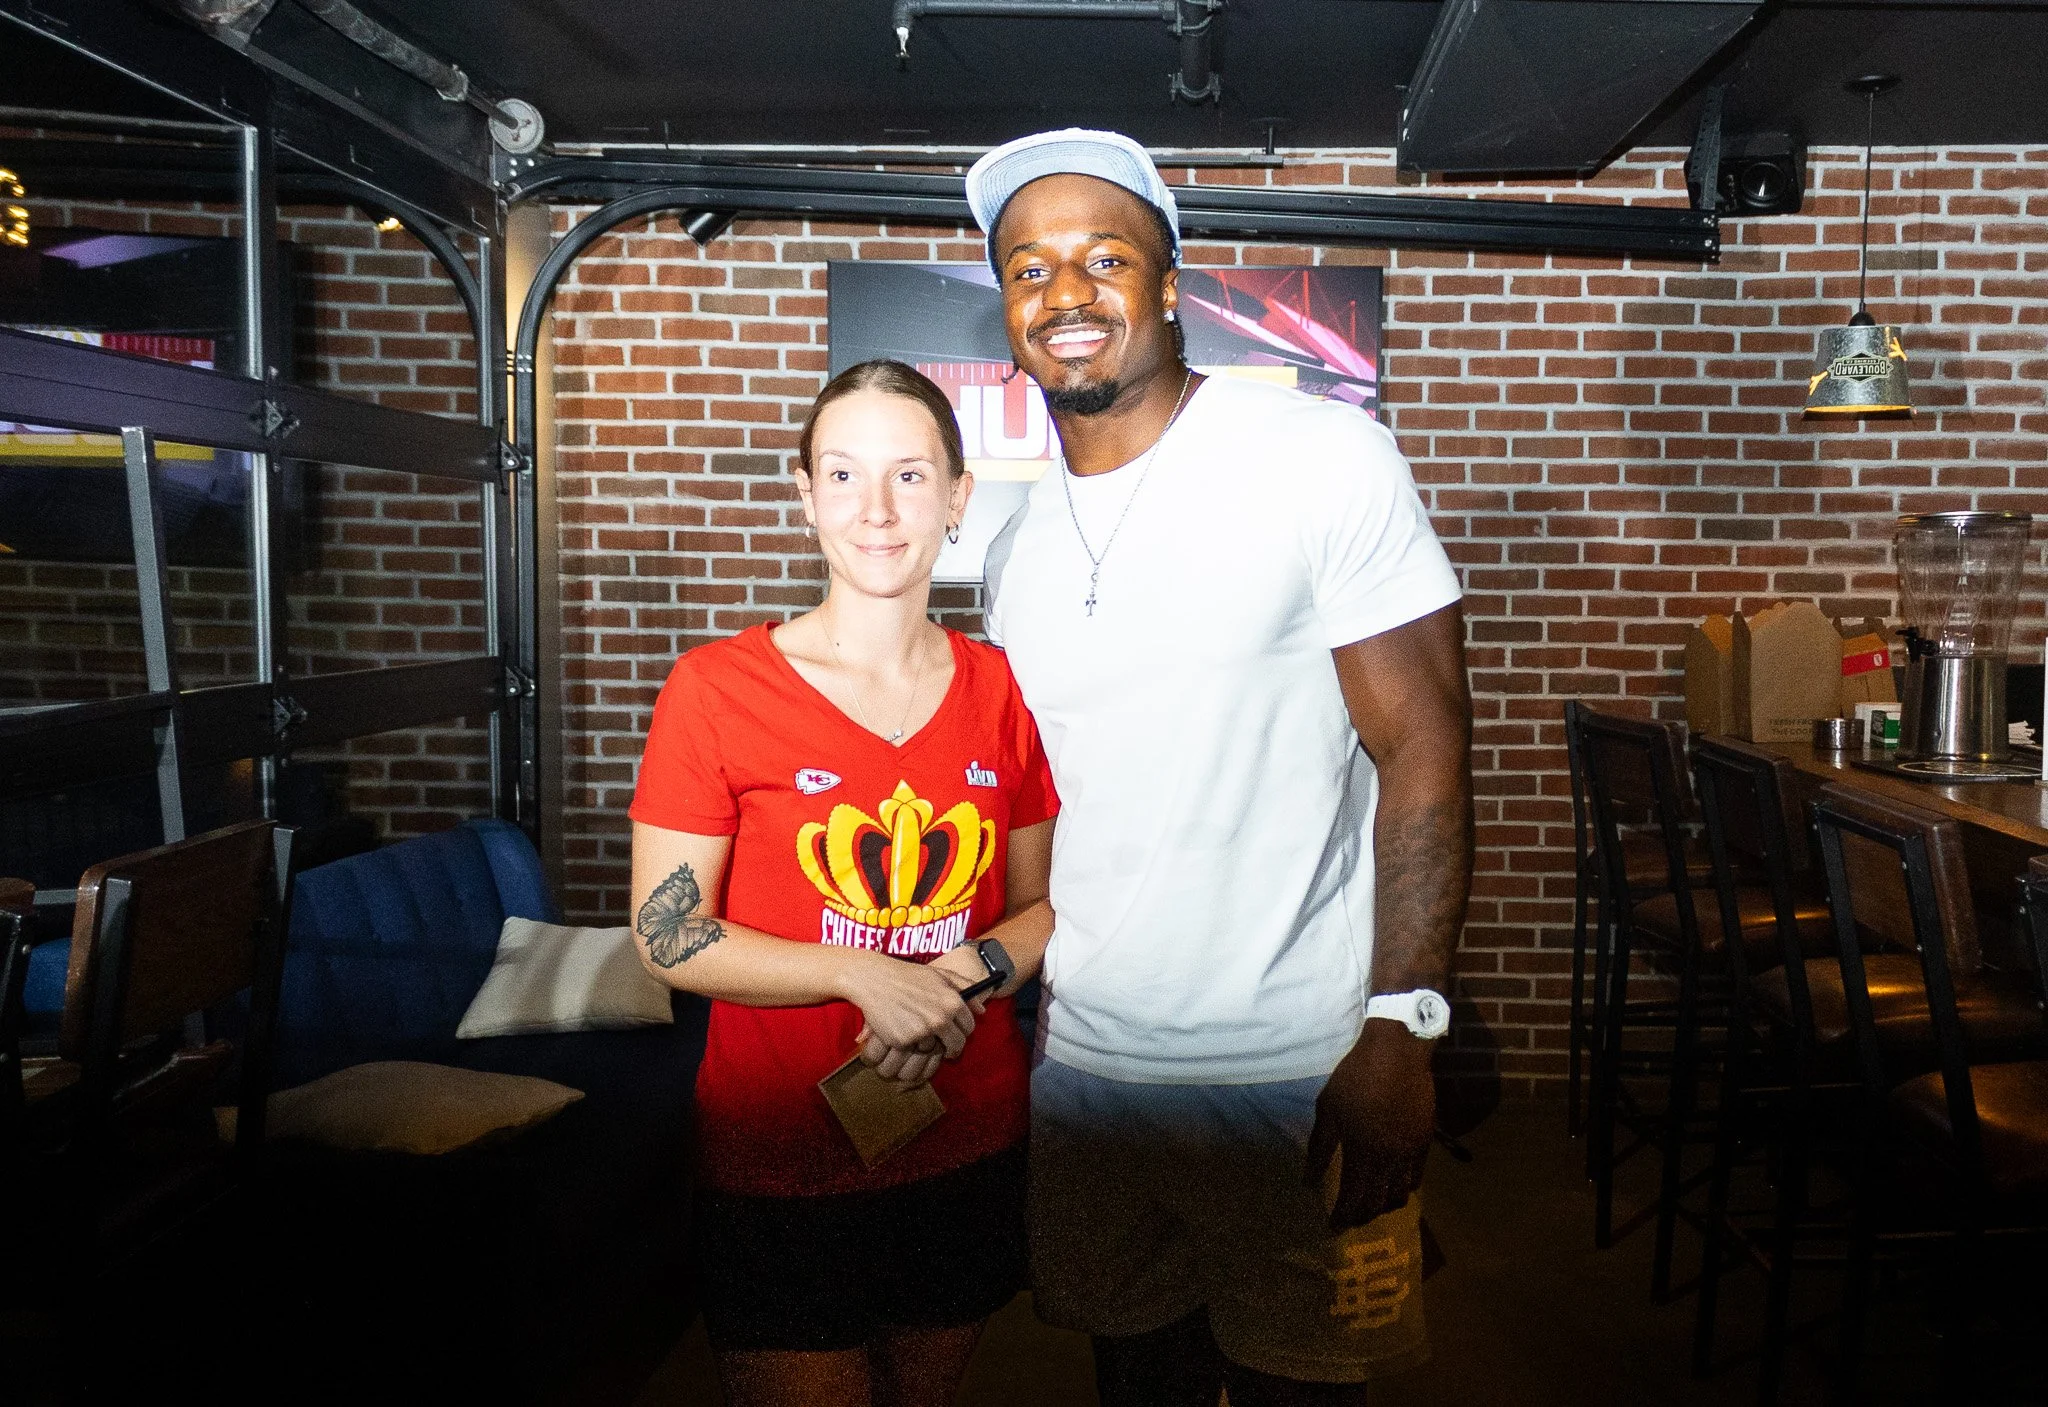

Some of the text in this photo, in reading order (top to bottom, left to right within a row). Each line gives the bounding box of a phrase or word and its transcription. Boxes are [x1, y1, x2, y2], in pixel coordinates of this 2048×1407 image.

[1835, 361, 1886, 375] BOULEVARD
[821, 908, 971, 955] CHIEFS KINGDOM
